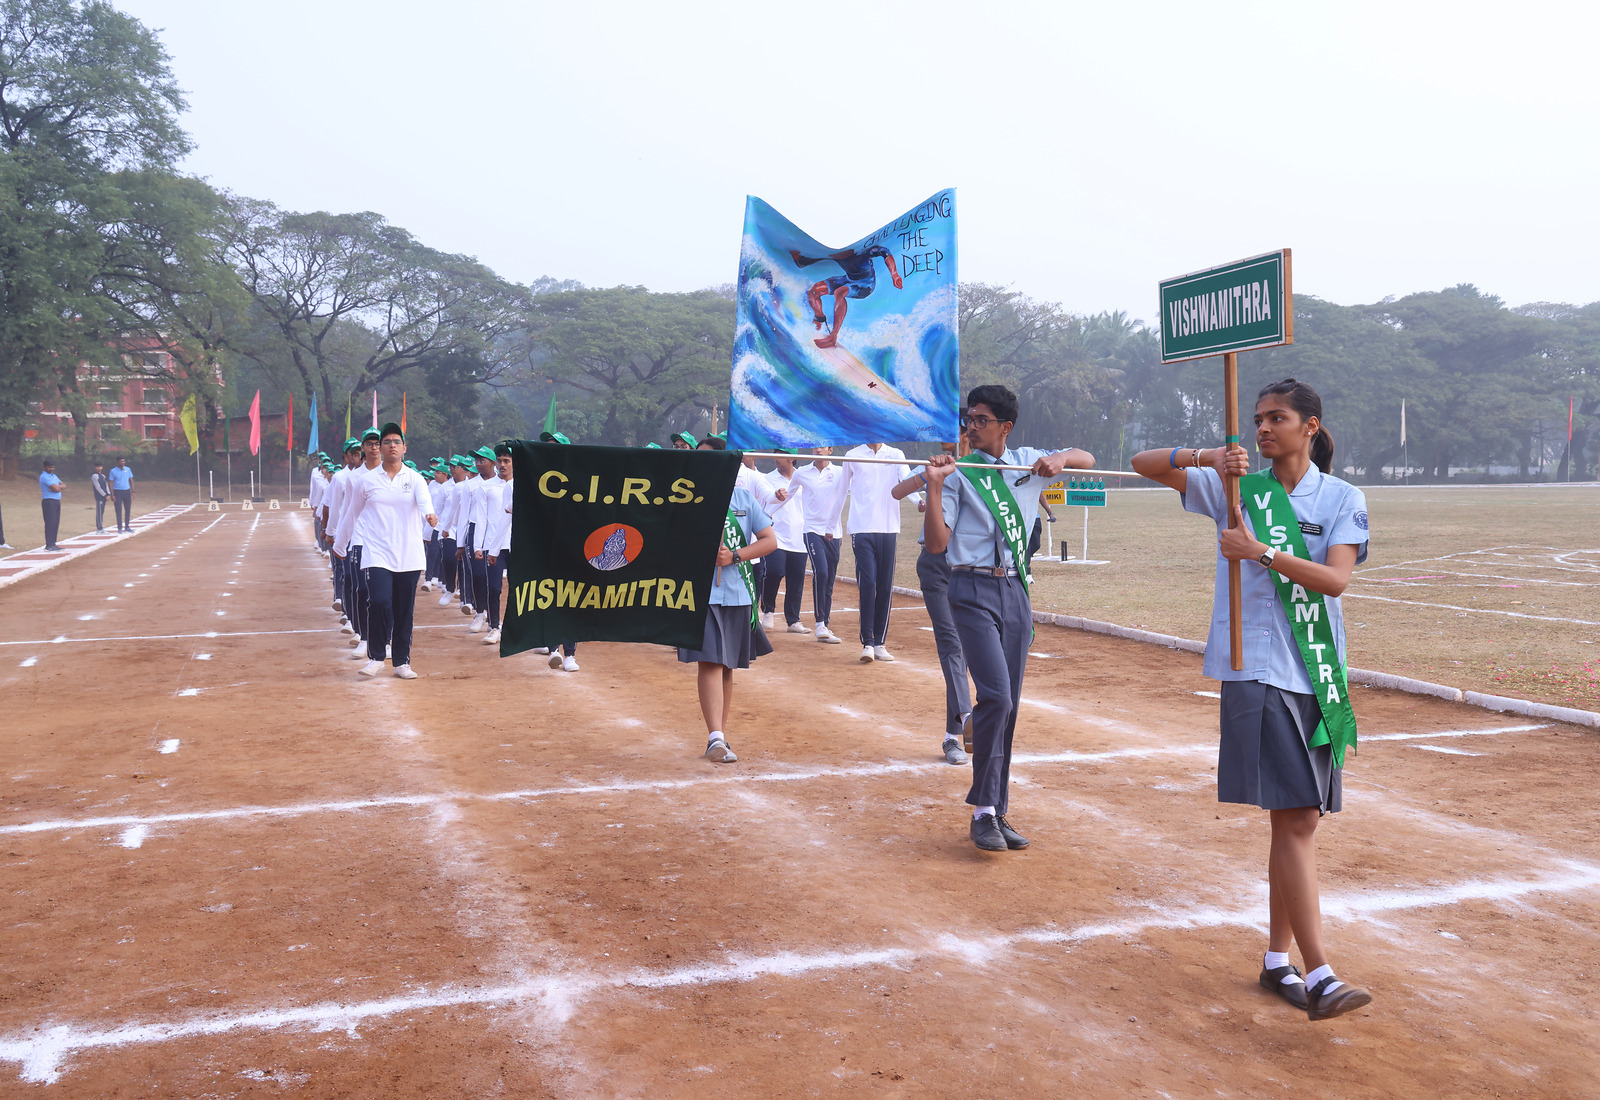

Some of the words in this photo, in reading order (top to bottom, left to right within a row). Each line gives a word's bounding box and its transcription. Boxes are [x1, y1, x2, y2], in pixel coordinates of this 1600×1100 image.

[863, 192, 952, 249] CHALLENGING
[896, 227, 929, 252] THE
[900, 248, 944, 279] DEEP
[1169, 279, 1272, 339] VISHWAMITHRA
[538, 470, 705, 506] C.I.R.S.
[515, 577, 696, 617] VISWAMITRA
